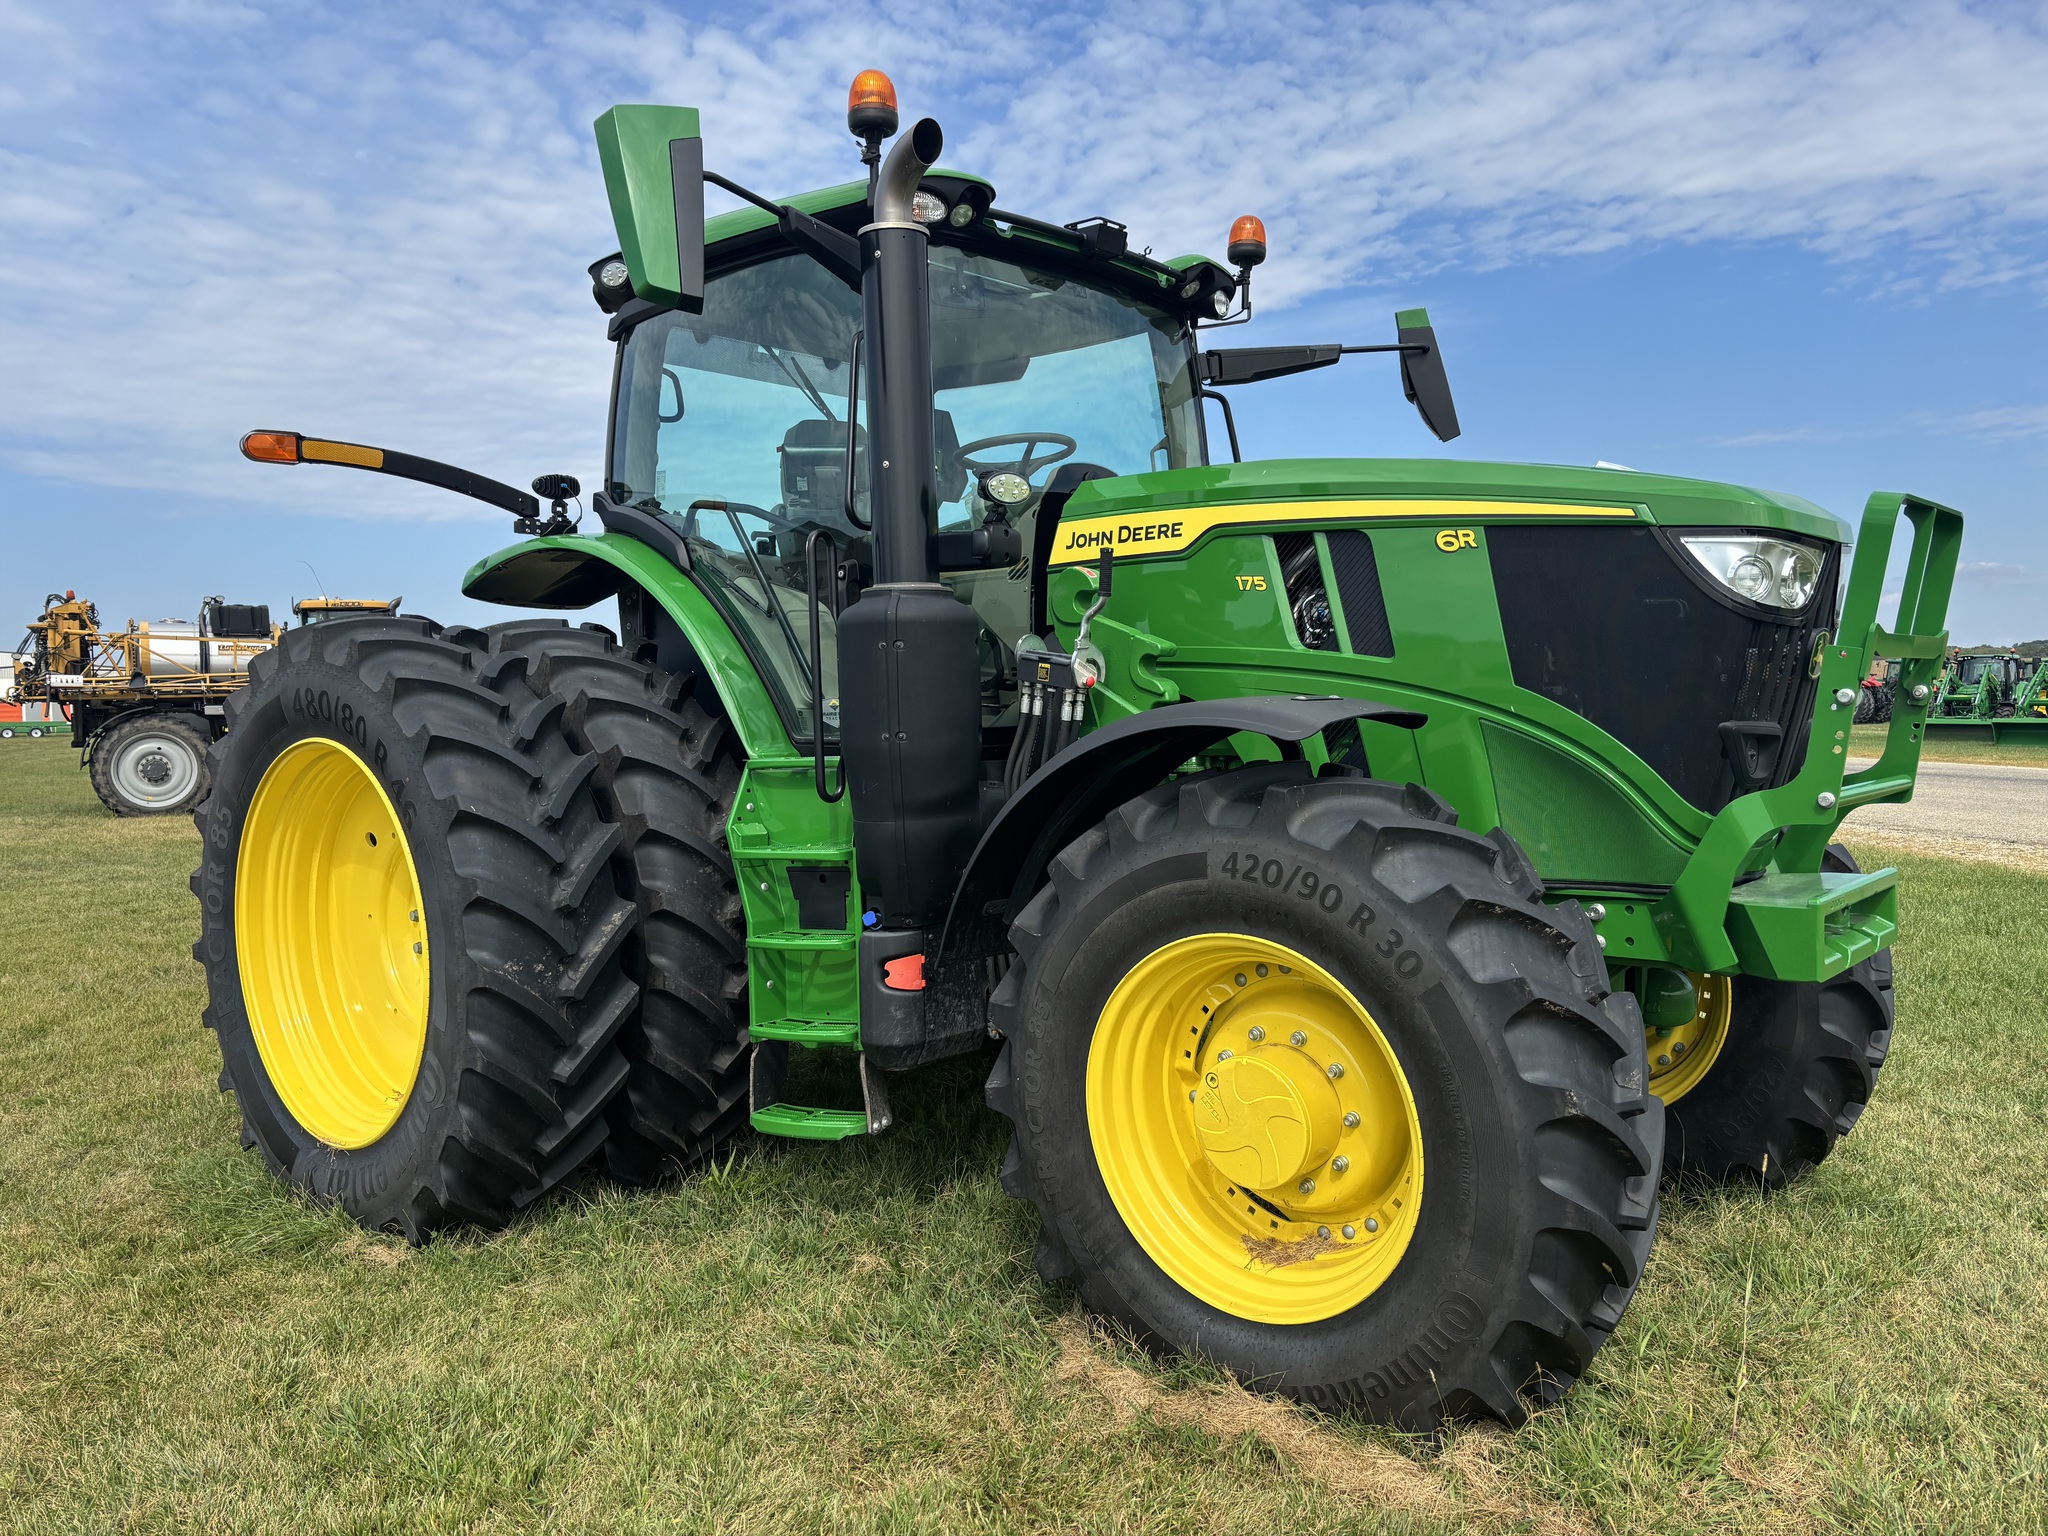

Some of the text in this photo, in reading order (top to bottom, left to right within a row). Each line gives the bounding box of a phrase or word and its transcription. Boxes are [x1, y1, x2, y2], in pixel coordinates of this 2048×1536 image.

[1065, 521, 1184, 551] JOHN DEERE
[1435, 528, 1479, 554] 6R
[1235, 575, 1268, 592] 175
[293, 687, 368, 749] 480/80
[374, 737, 388, 777] R
[206, 800, 242, 1043] TRACTOR 85
[1220, 851, 1344, 915] 420/90
[1346, 900, 1378, 938] R
[1375, 927, 1425, 982] 30
[1024, 995, 1062, 1204] TRACTOR 85
[1200, 1096, 1222, 1124] LEVEL
[1203, 1091, 1216, 1106] OIL
